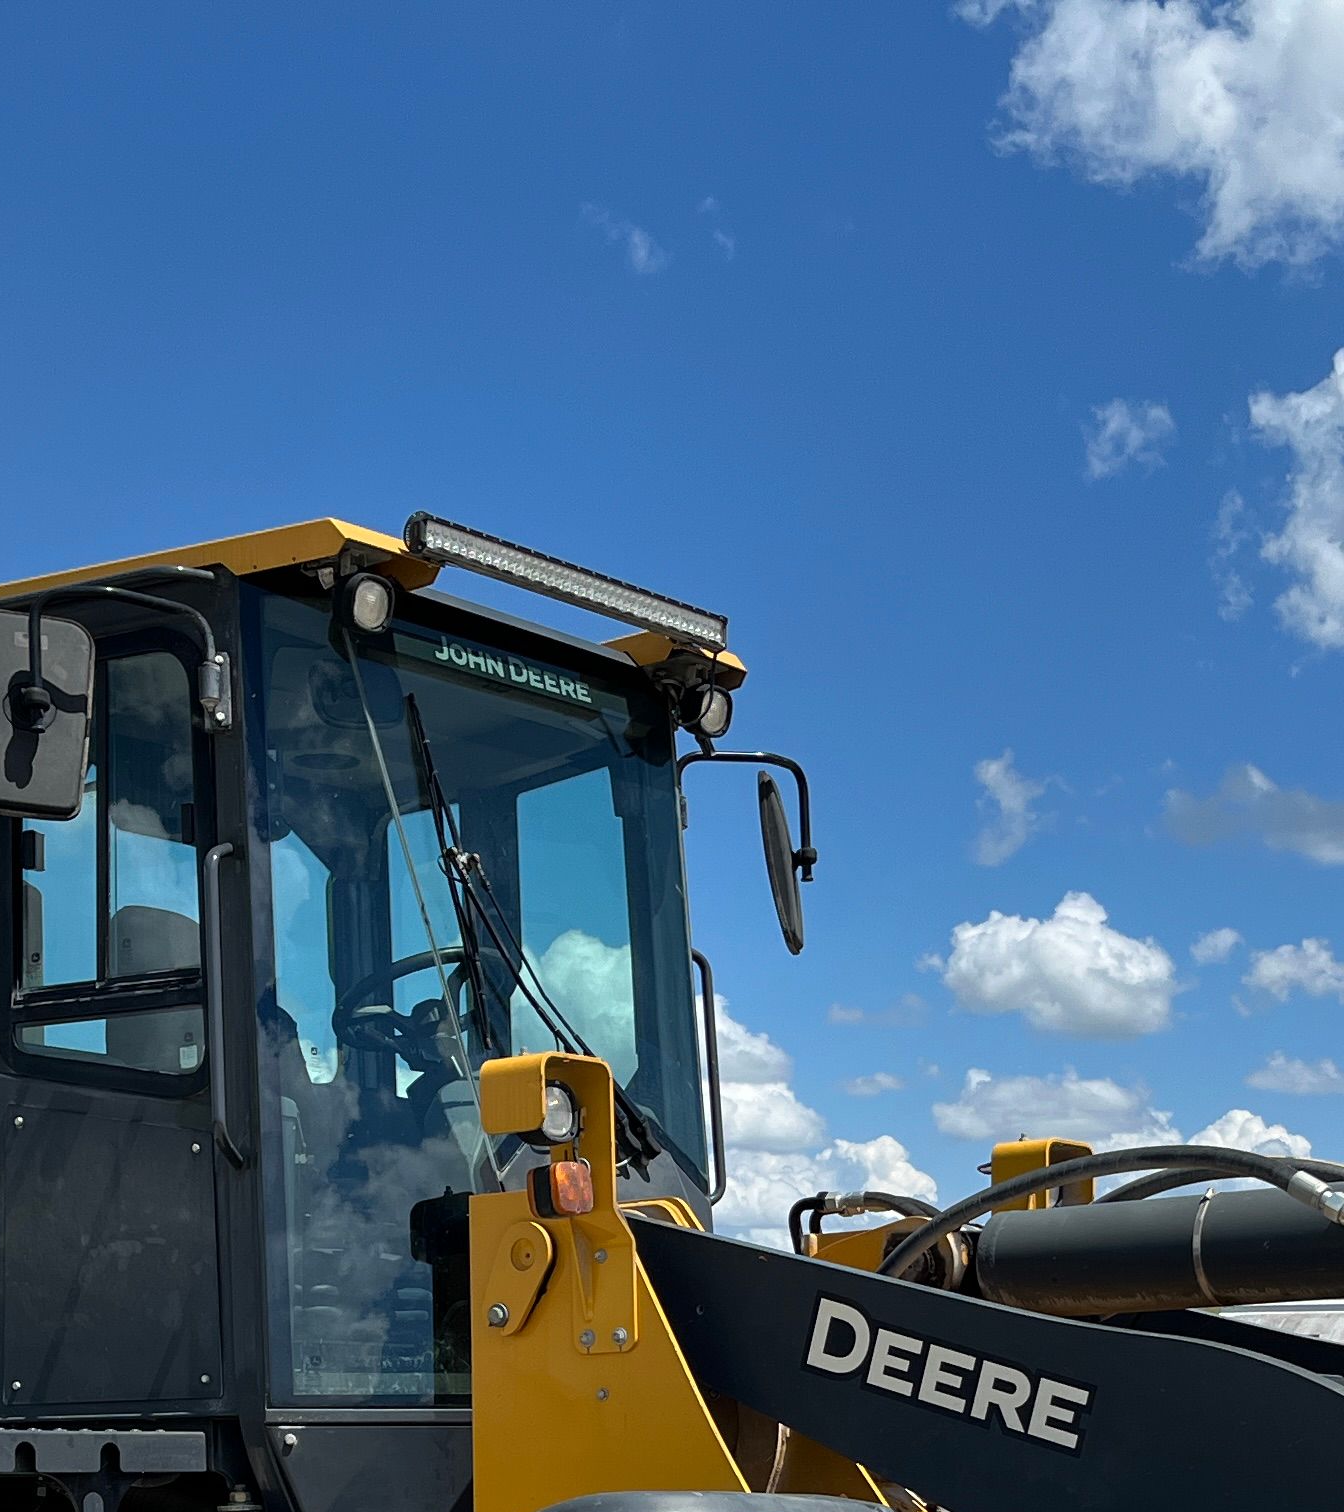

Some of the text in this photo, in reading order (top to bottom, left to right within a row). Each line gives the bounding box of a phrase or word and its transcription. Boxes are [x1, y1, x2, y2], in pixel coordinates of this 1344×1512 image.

[435, 635, 593, 704] JOHN DEERE
[805, 1297, 1090, 1450] DEERE
